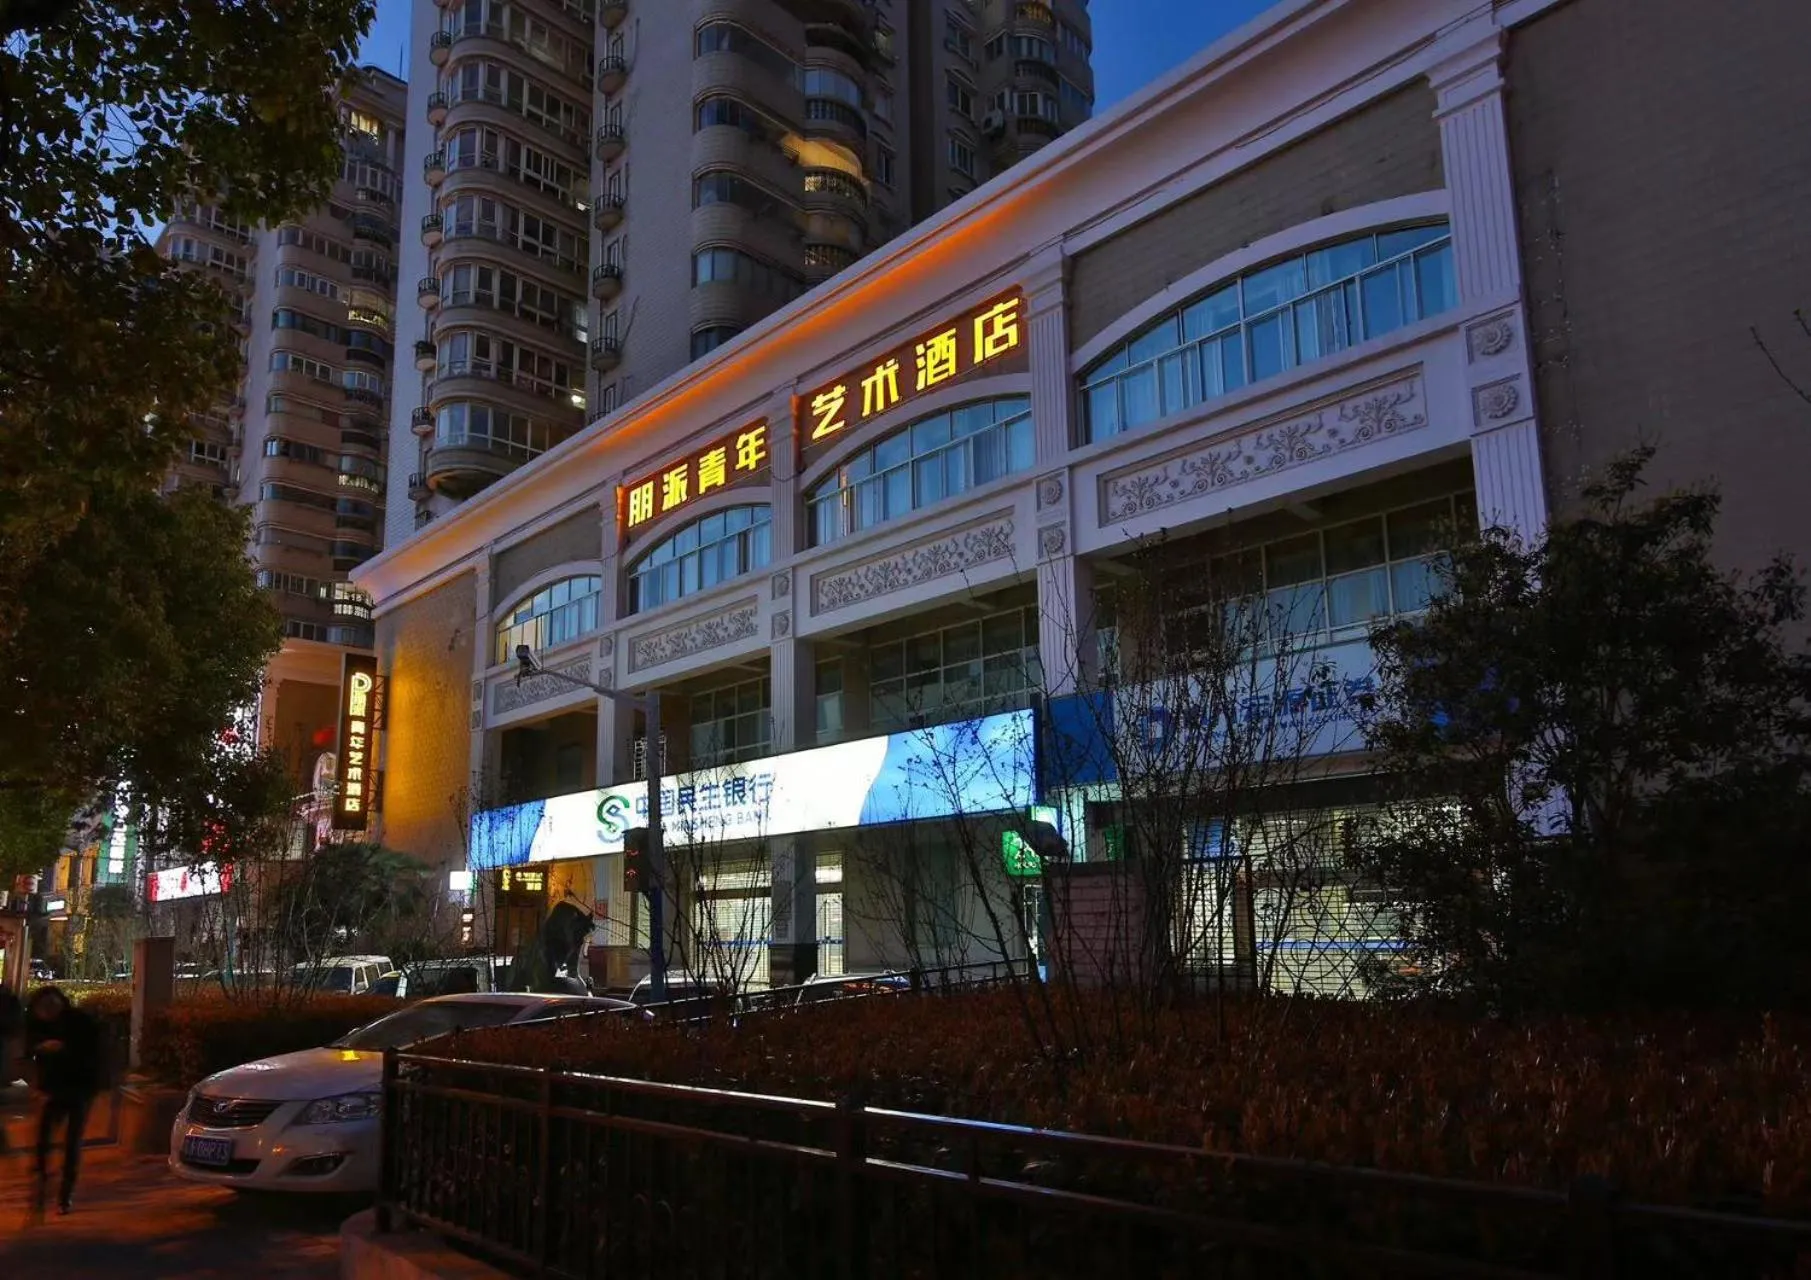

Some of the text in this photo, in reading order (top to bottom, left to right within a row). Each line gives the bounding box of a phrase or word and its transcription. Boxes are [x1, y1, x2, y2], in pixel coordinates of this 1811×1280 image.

[627, 297, 1021, 527] 朋派青年 艺术酒店
[635, 773, 775, 816] 中国民生银行
[737, 808, 768, 825] BAN
